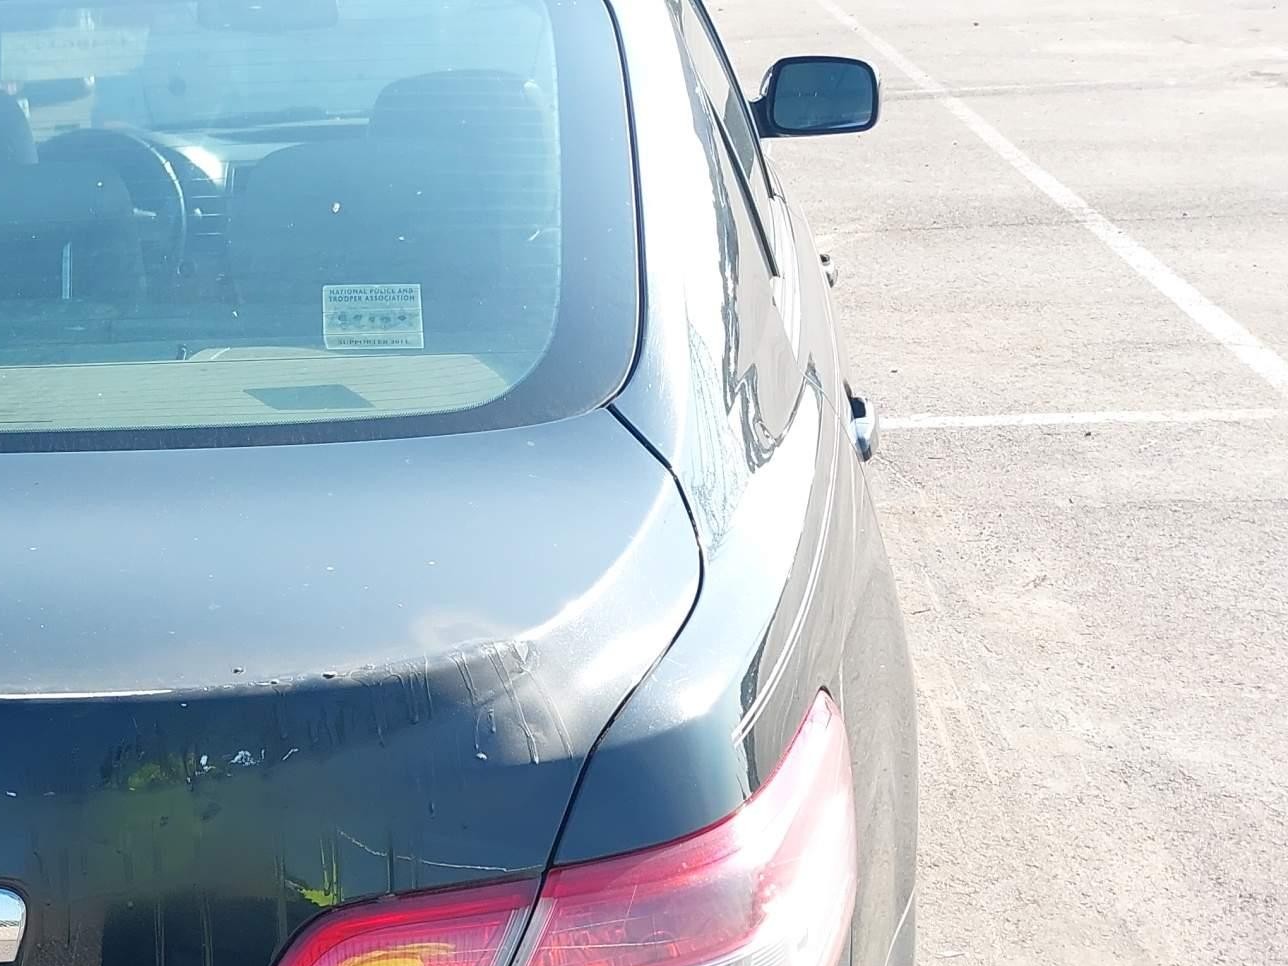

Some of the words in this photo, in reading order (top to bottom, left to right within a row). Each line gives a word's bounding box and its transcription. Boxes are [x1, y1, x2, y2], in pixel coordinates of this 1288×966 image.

[329, 288, 368, 296] NATIONAL
[329, 295, 362, 303] TROOPER
[365, 294, 415, 303] ASSOCIATION
